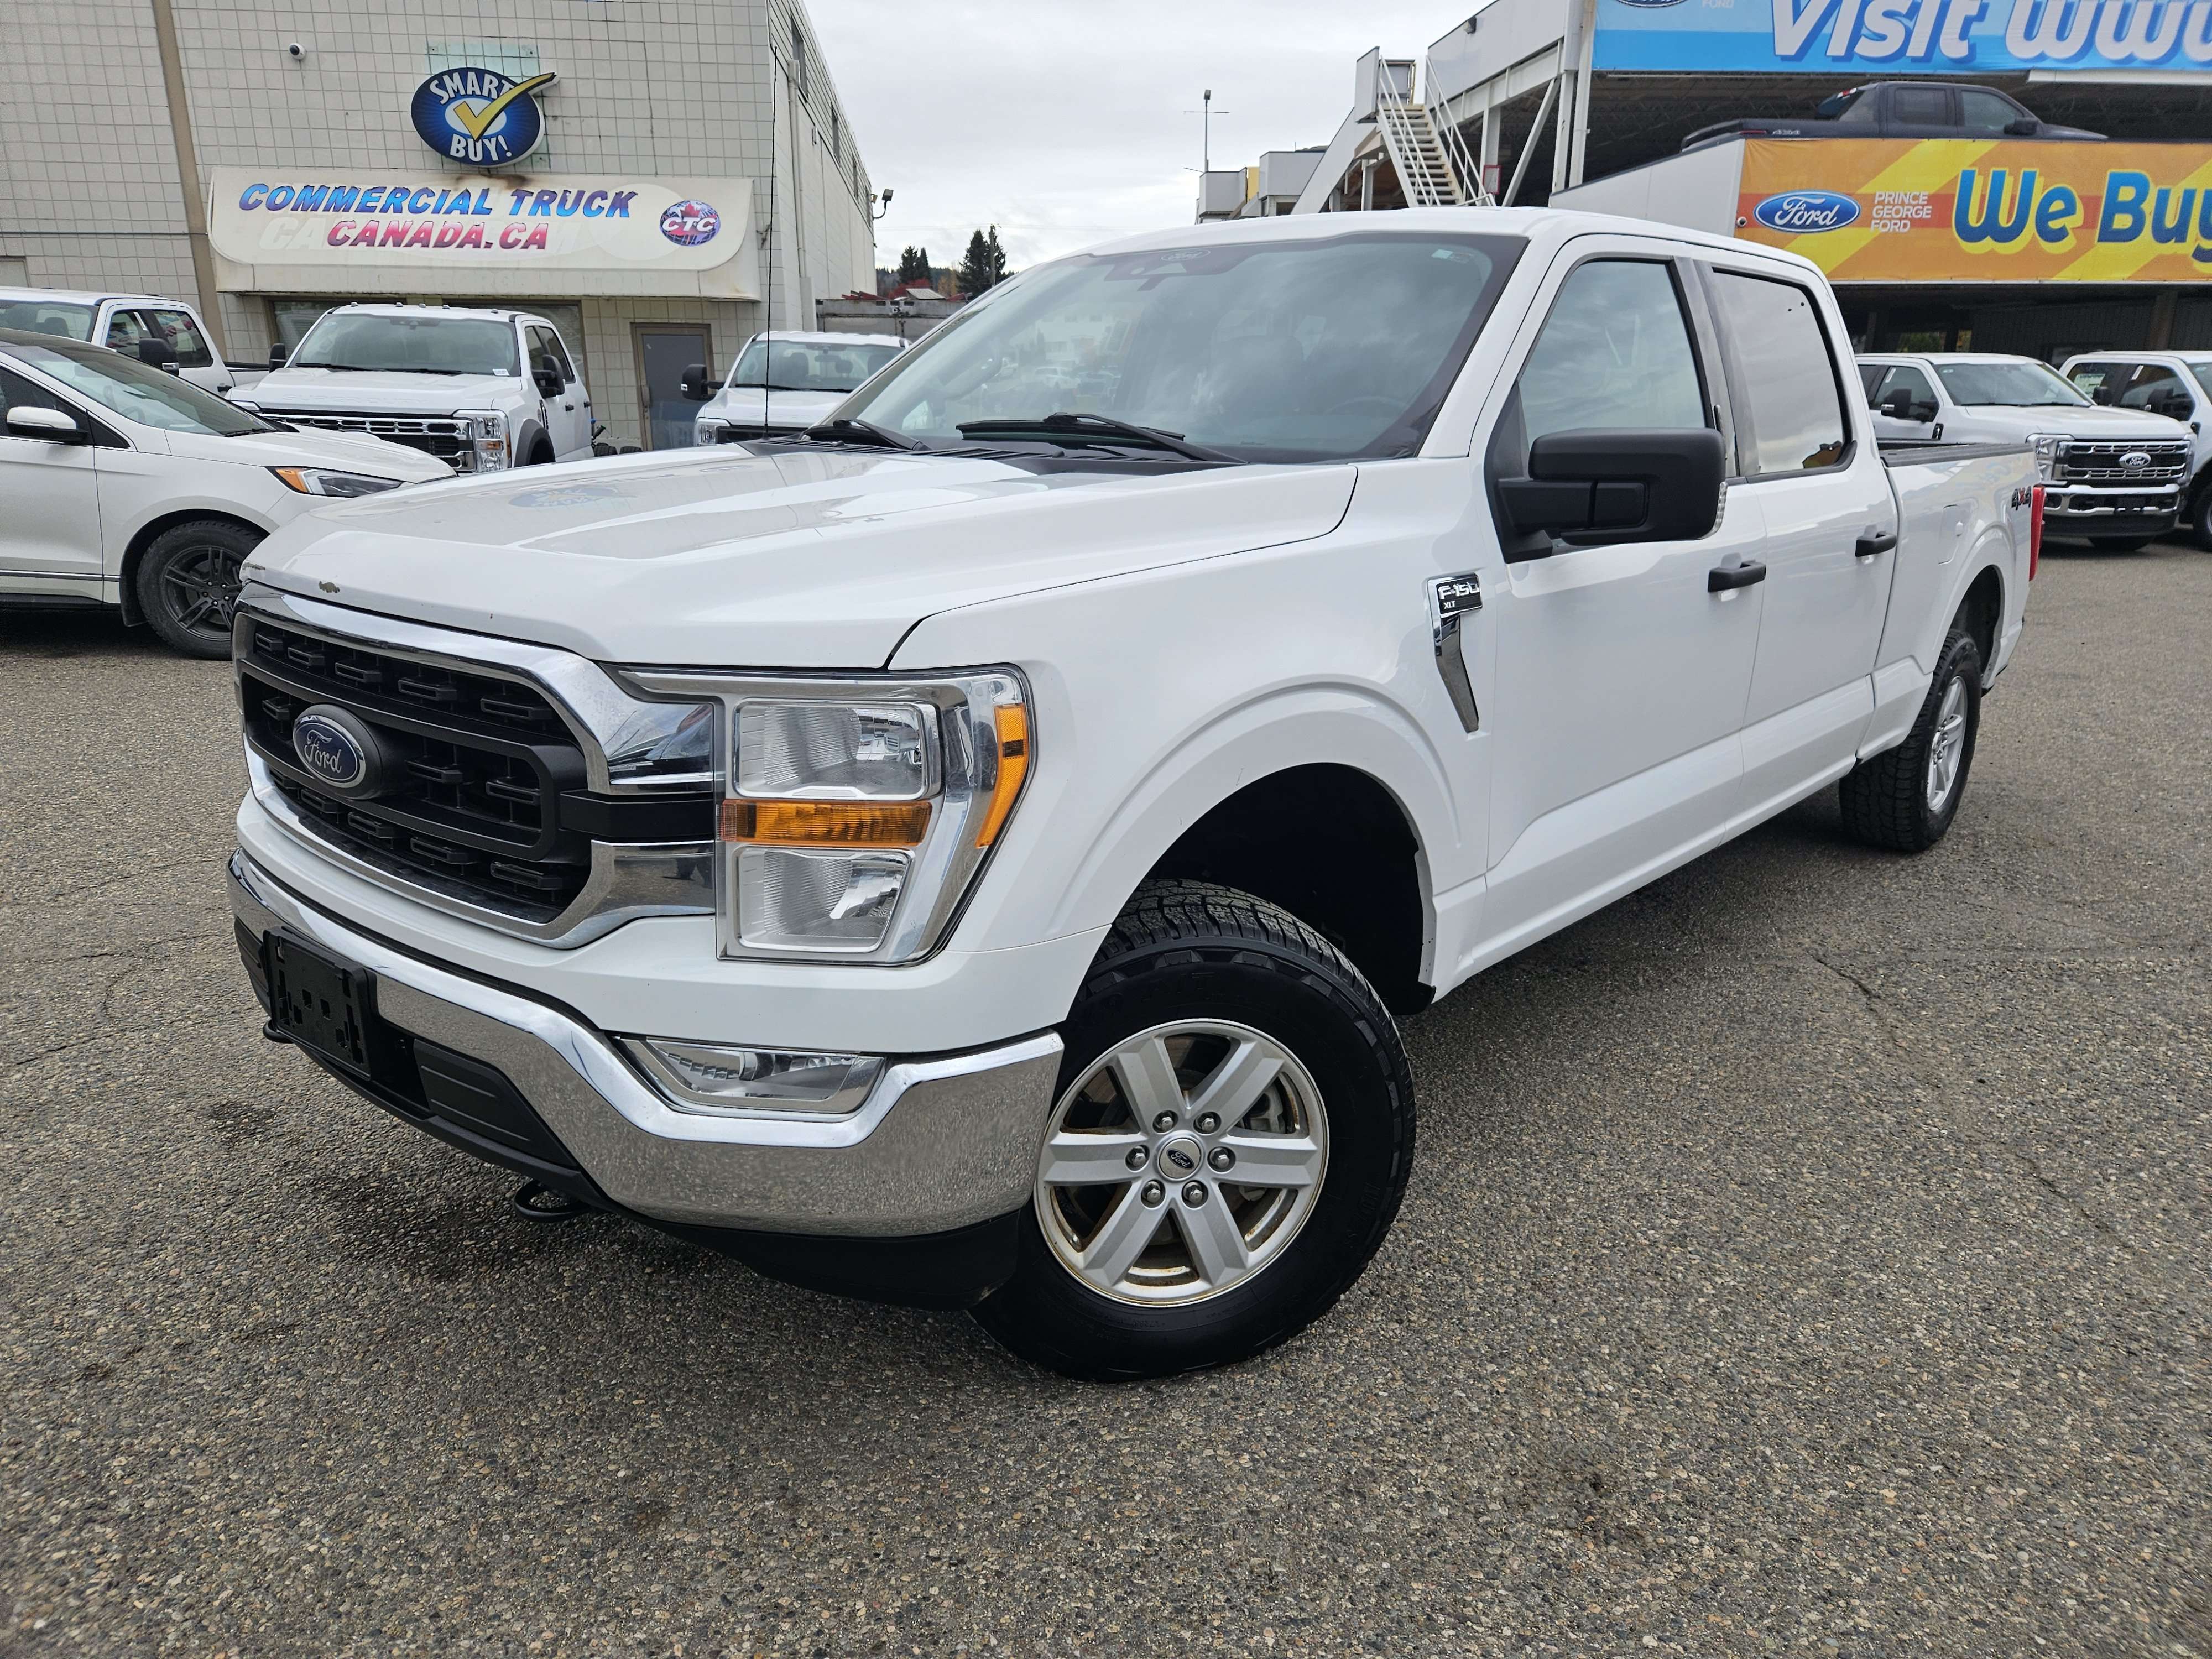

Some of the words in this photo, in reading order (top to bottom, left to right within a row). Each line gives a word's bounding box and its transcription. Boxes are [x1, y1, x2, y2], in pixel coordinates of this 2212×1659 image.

[1772, 0, 1982, 59] Visit
[429, 71, 514, 105] SMART
[450, 133, 512, 162] BUY!
[239, 183, 493, 215] COMMERCIAL
[509, 188, 638, 218] TRUCK
[1774, 196, 1841, 226] Ford
[1872, 205, 1933, 218] GEORGE
[1874, 191, 1929, 205] PRINCE
[1953, 169, 2078, 244] We
[327, 220, 549, 249] CANADA.CA
[662, 216, 717, 232] CTC
[1870, 221, 1911, 233] FORD
[1438, 581, 1480, 600] F-150
[1443, 601, 1456, 609] XLT
[304, 729, 342, 774] Ford
